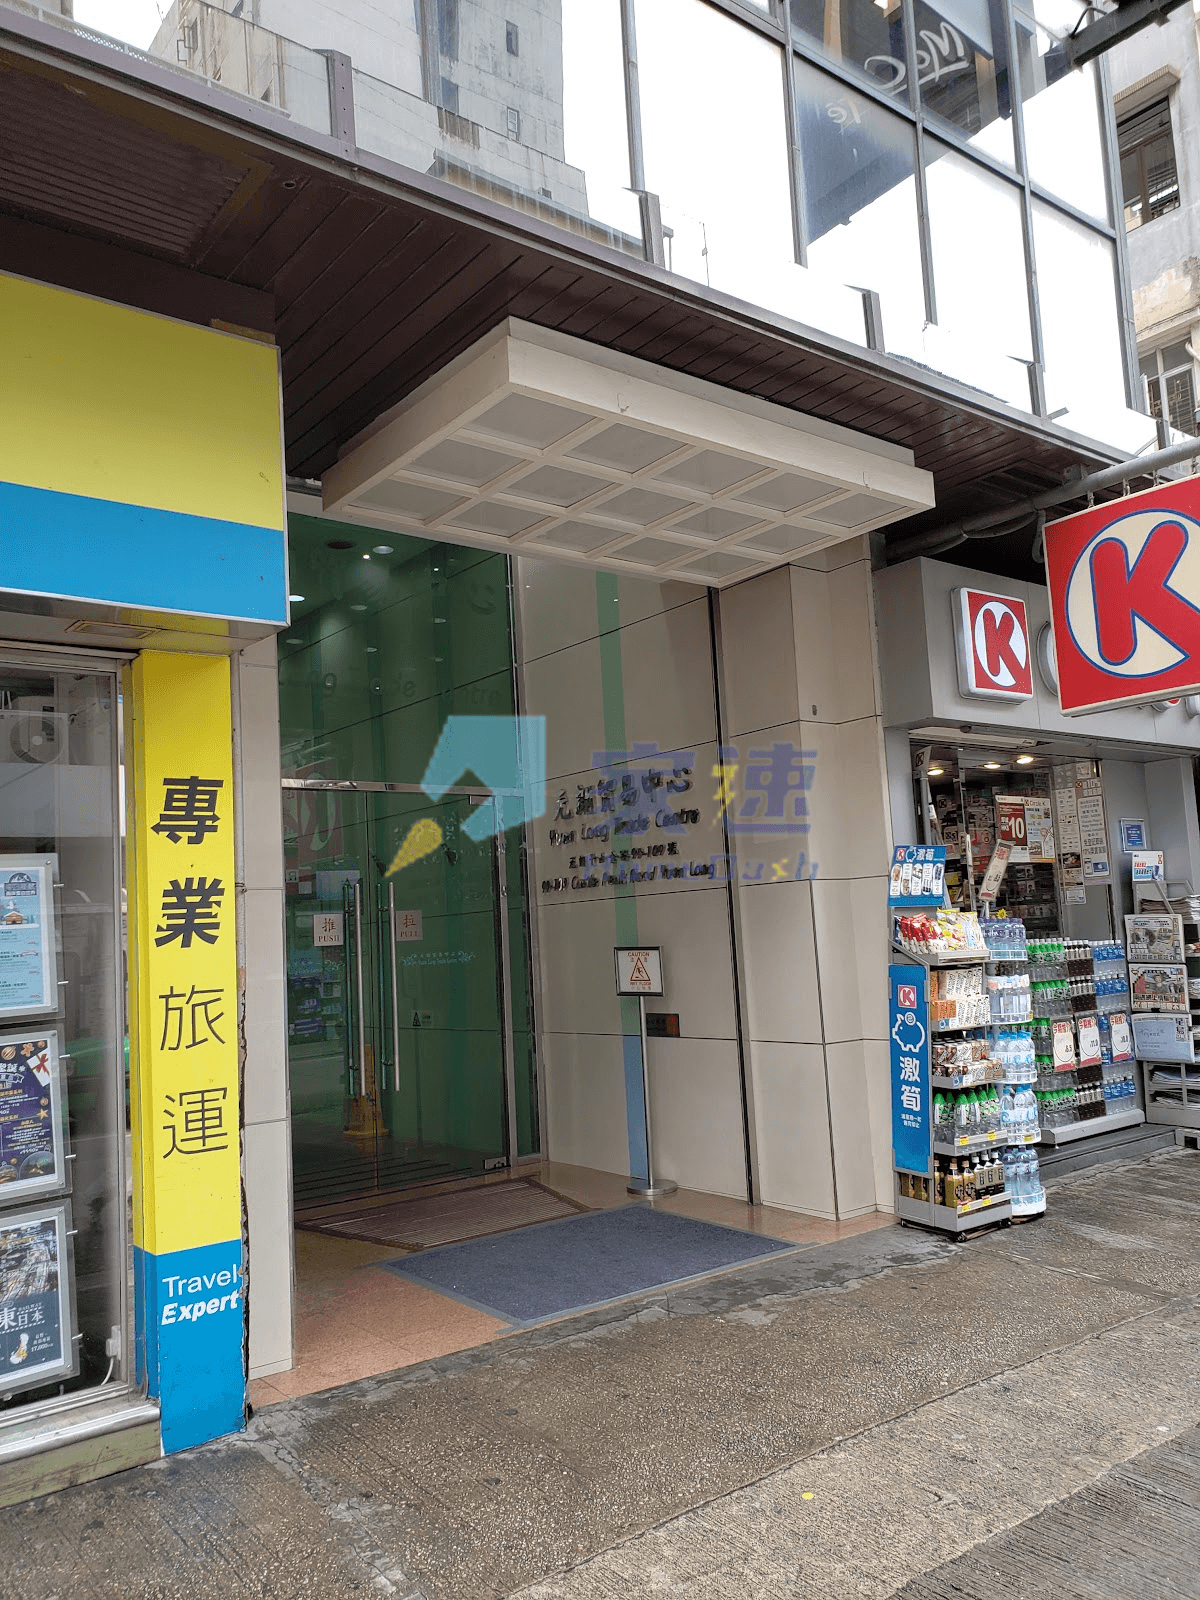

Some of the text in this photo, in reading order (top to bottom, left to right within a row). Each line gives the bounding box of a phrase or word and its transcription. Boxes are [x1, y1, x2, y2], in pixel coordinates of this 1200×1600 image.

[1090, 519, 1200, 667] K
[983, 608, 1026, 680] K
[1009, 817, 1025, 838] 10
[322, 917, 336, 932] 推
[400, 930, 418, 938] PULL
[403, 914, 416, 928] 拉
[318, 935, 340, 943] PUSH
[151, 774, 229, 1160] 專業旅運
[900, 1055, 921, 1112] 激筍
[161, 1263, 237, 1298] Travel
[161, 1289, 240, 1326] Expert
